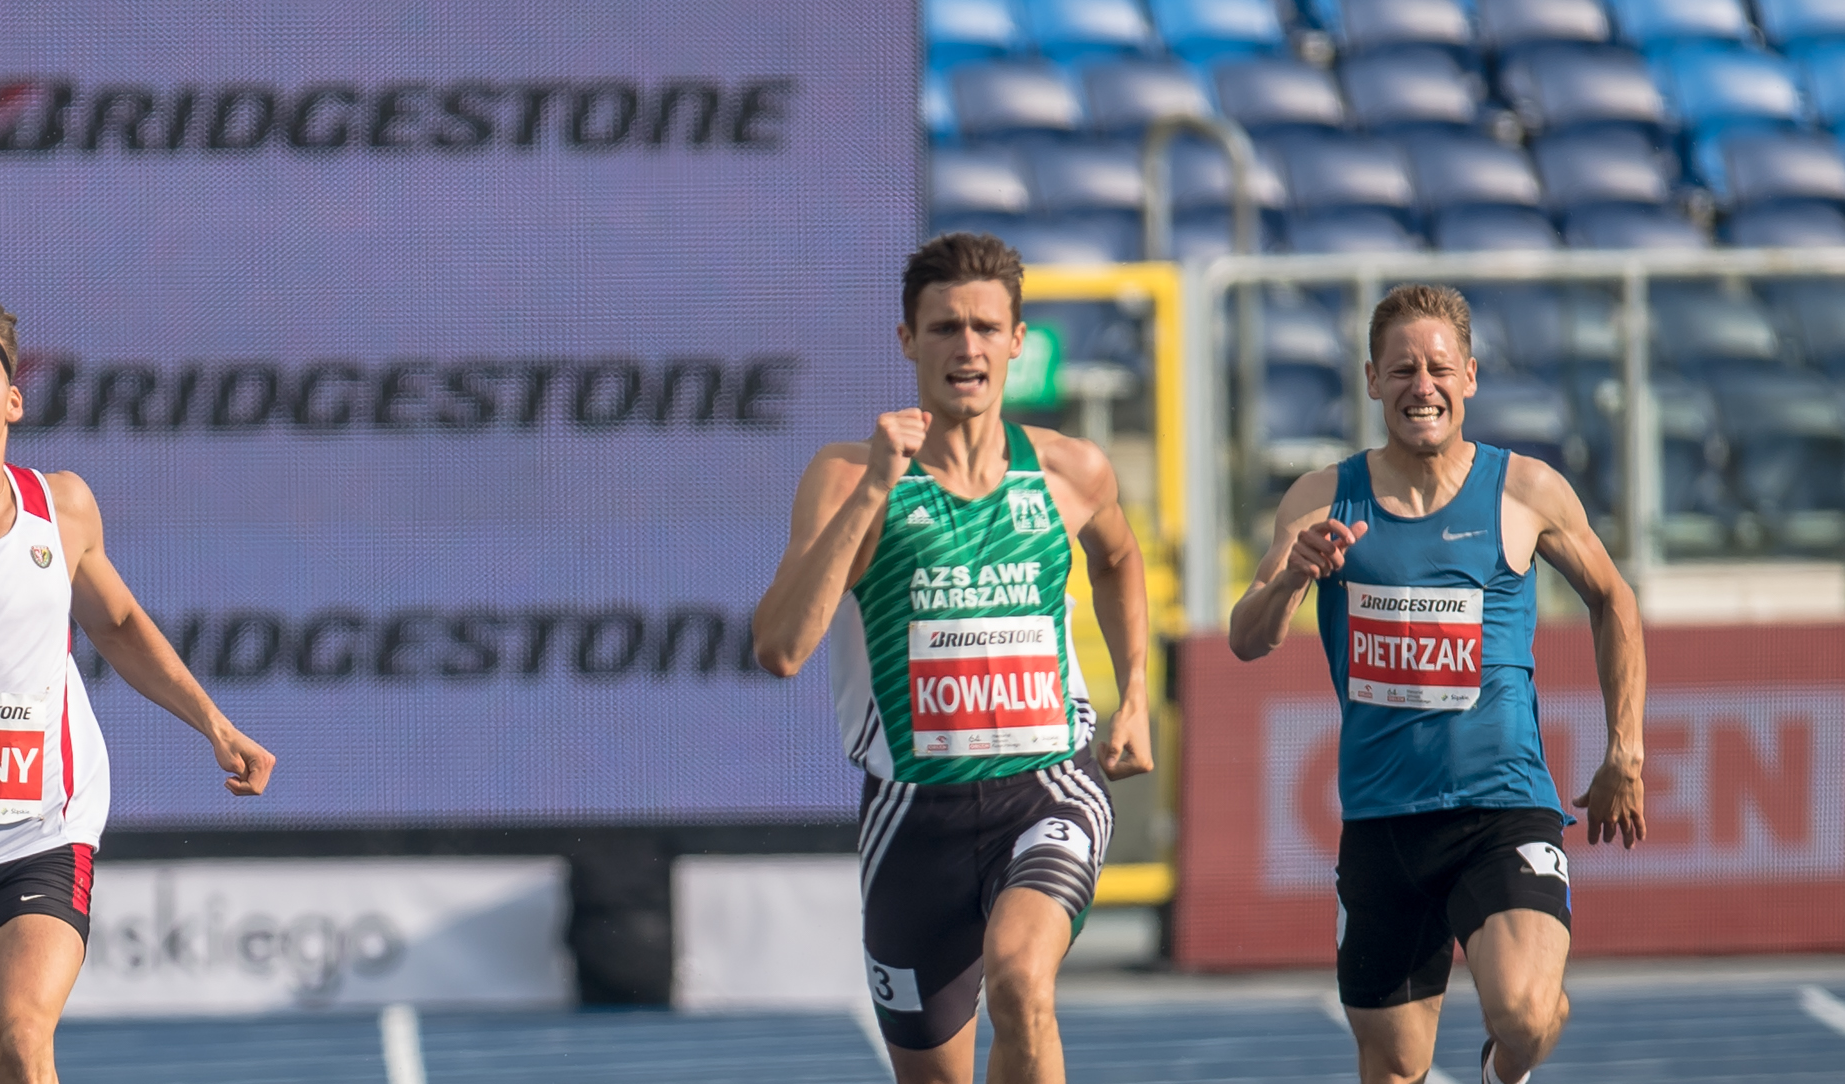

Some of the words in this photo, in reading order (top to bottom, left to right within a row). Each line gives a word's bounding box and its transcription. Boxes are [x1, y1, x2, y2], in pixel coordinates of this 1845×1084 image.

[910, 566, 972, 588] AZS
[978, 562, 1042, 585] AWF
[910, 585, 1042, 610] WARSZAWA
[1361, 594, 1467, 612] BRIDGESTONE
[929, 629, 1043, 648] BRIDGESTONE
[1353, 630, 1477, 673] PIETRZAK
[917, 671, 1060, 714] KOWALUK
[1043, 820, 1069, 841] 3
[1544, 846, 1566, 878] 2
[872, 965, 894, 1001] 3
